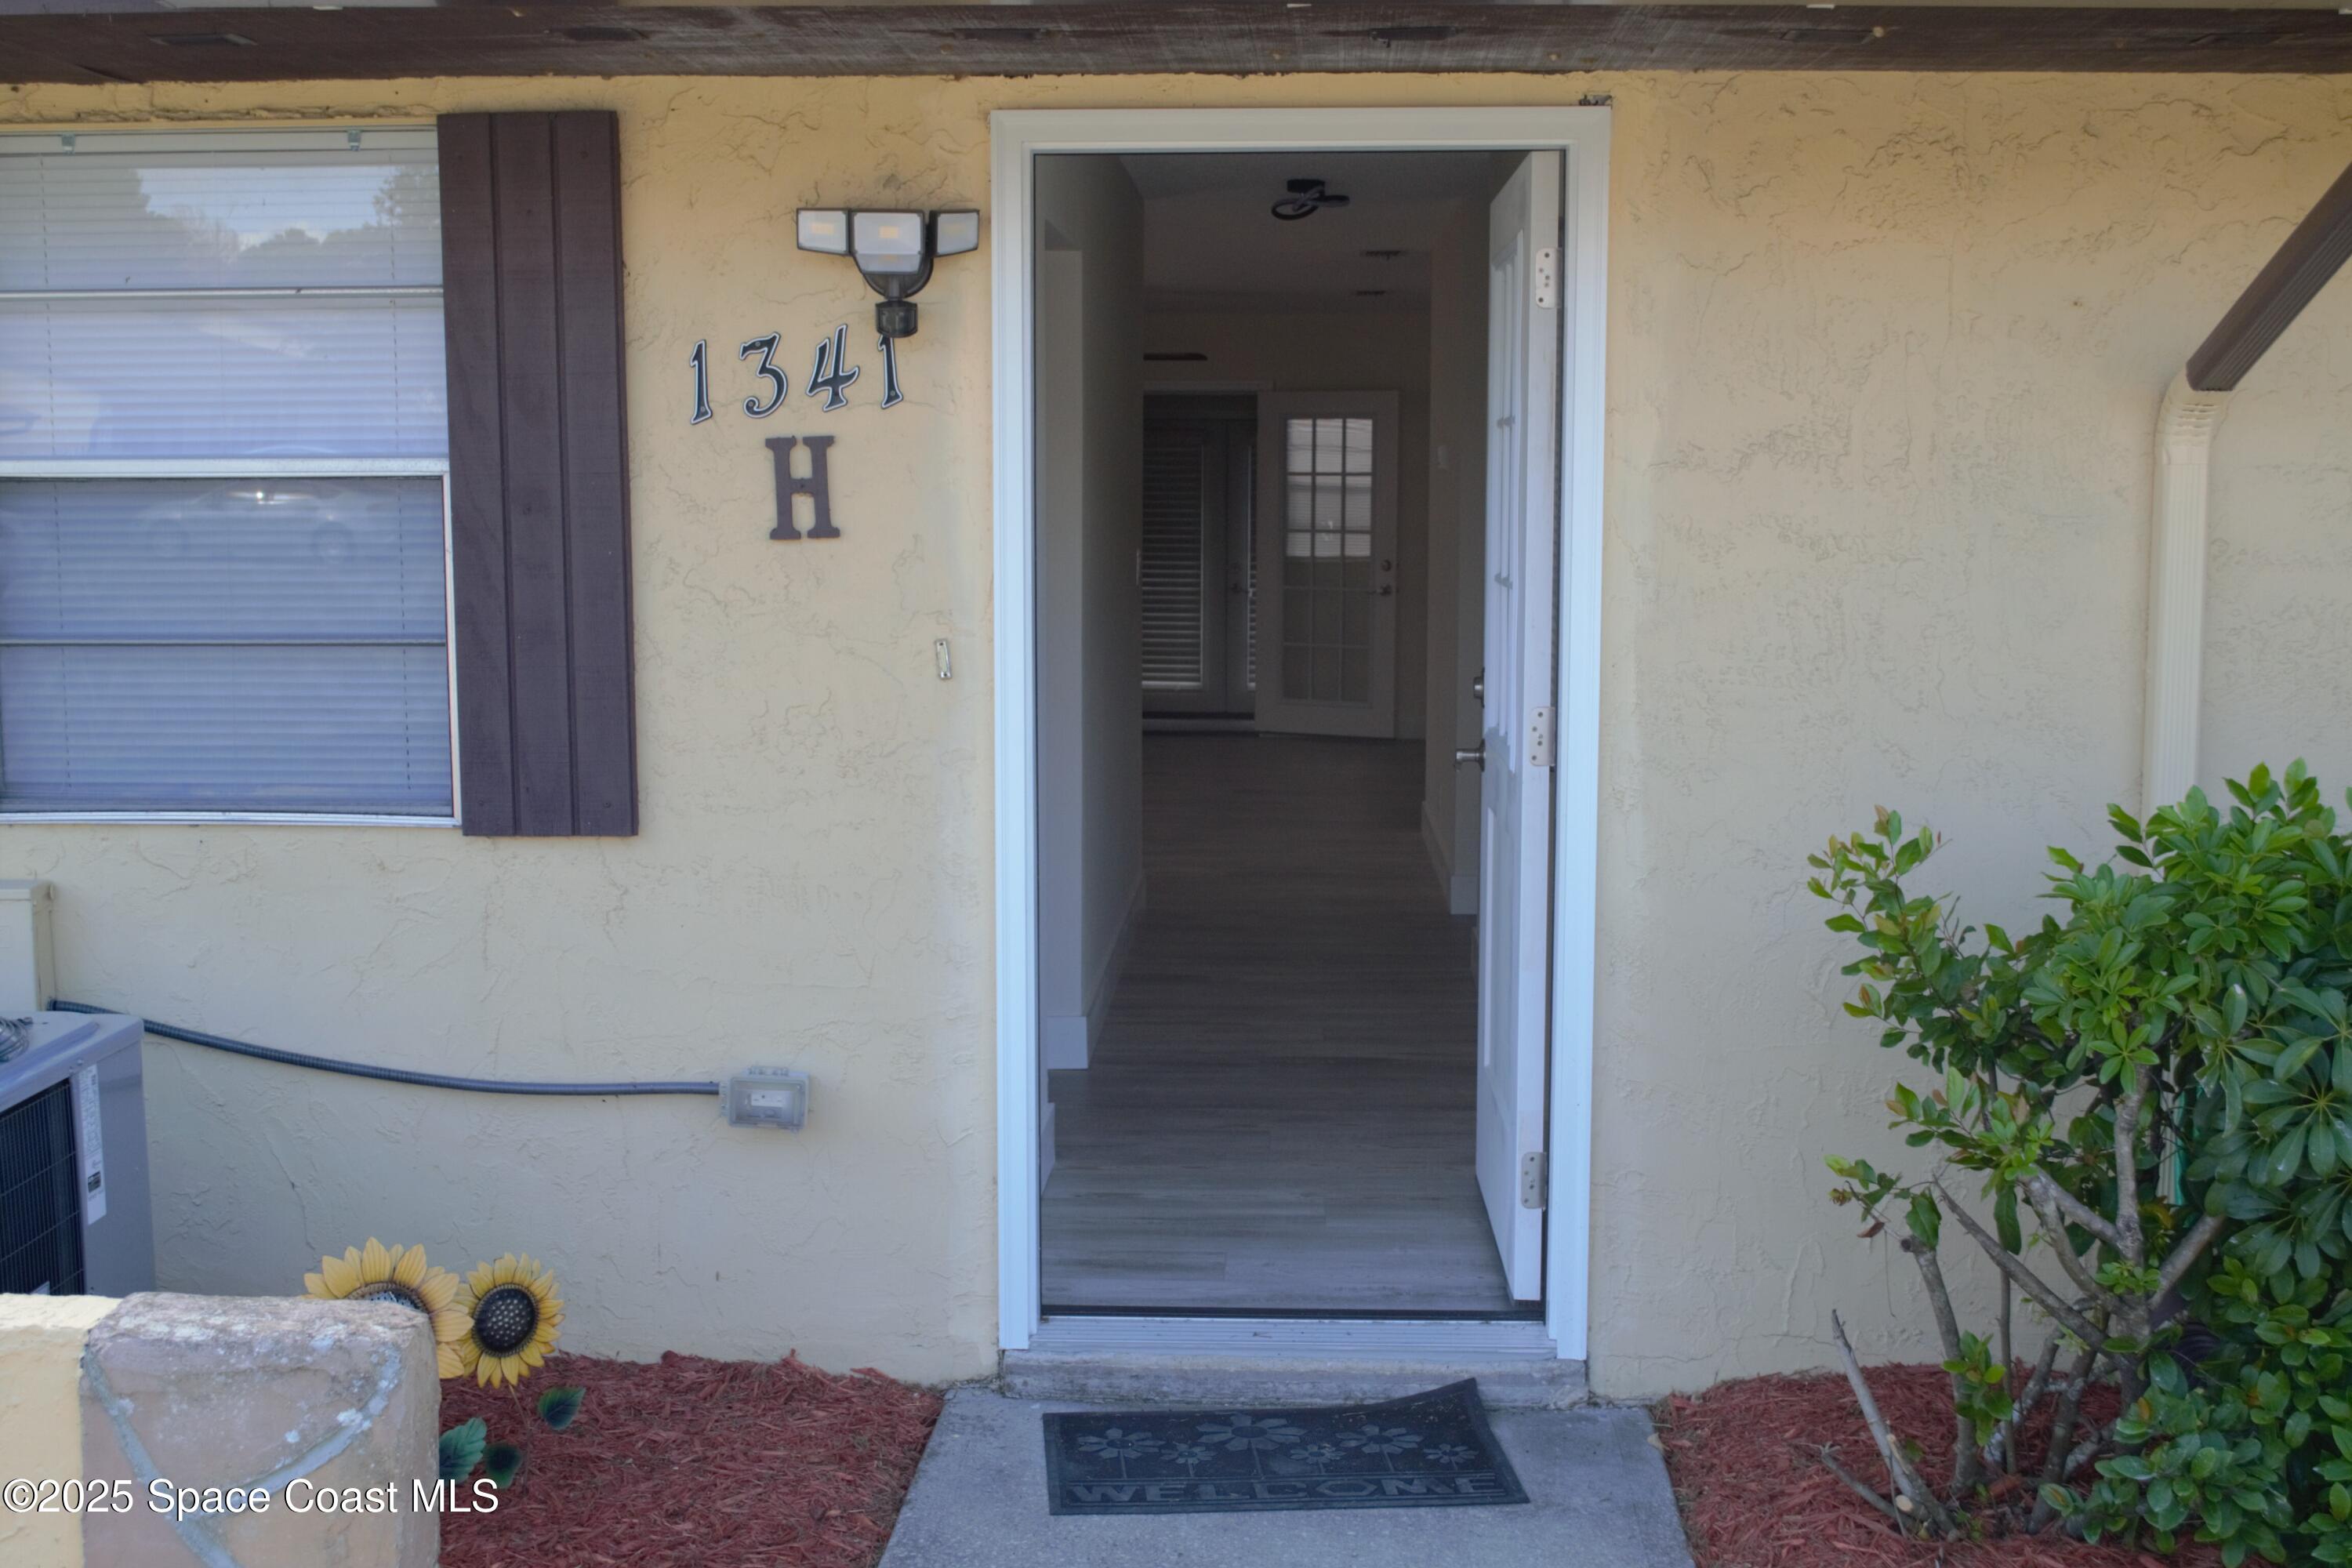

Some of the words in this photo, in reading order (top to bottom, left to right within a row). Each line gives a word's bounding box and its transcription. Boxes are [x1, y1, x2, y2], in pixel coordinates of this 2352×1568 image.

[689, 323, 903, 425] 1341
[764, 435, 840, 540] H
[1070, 1475, 1505, 1501] WELCOME
